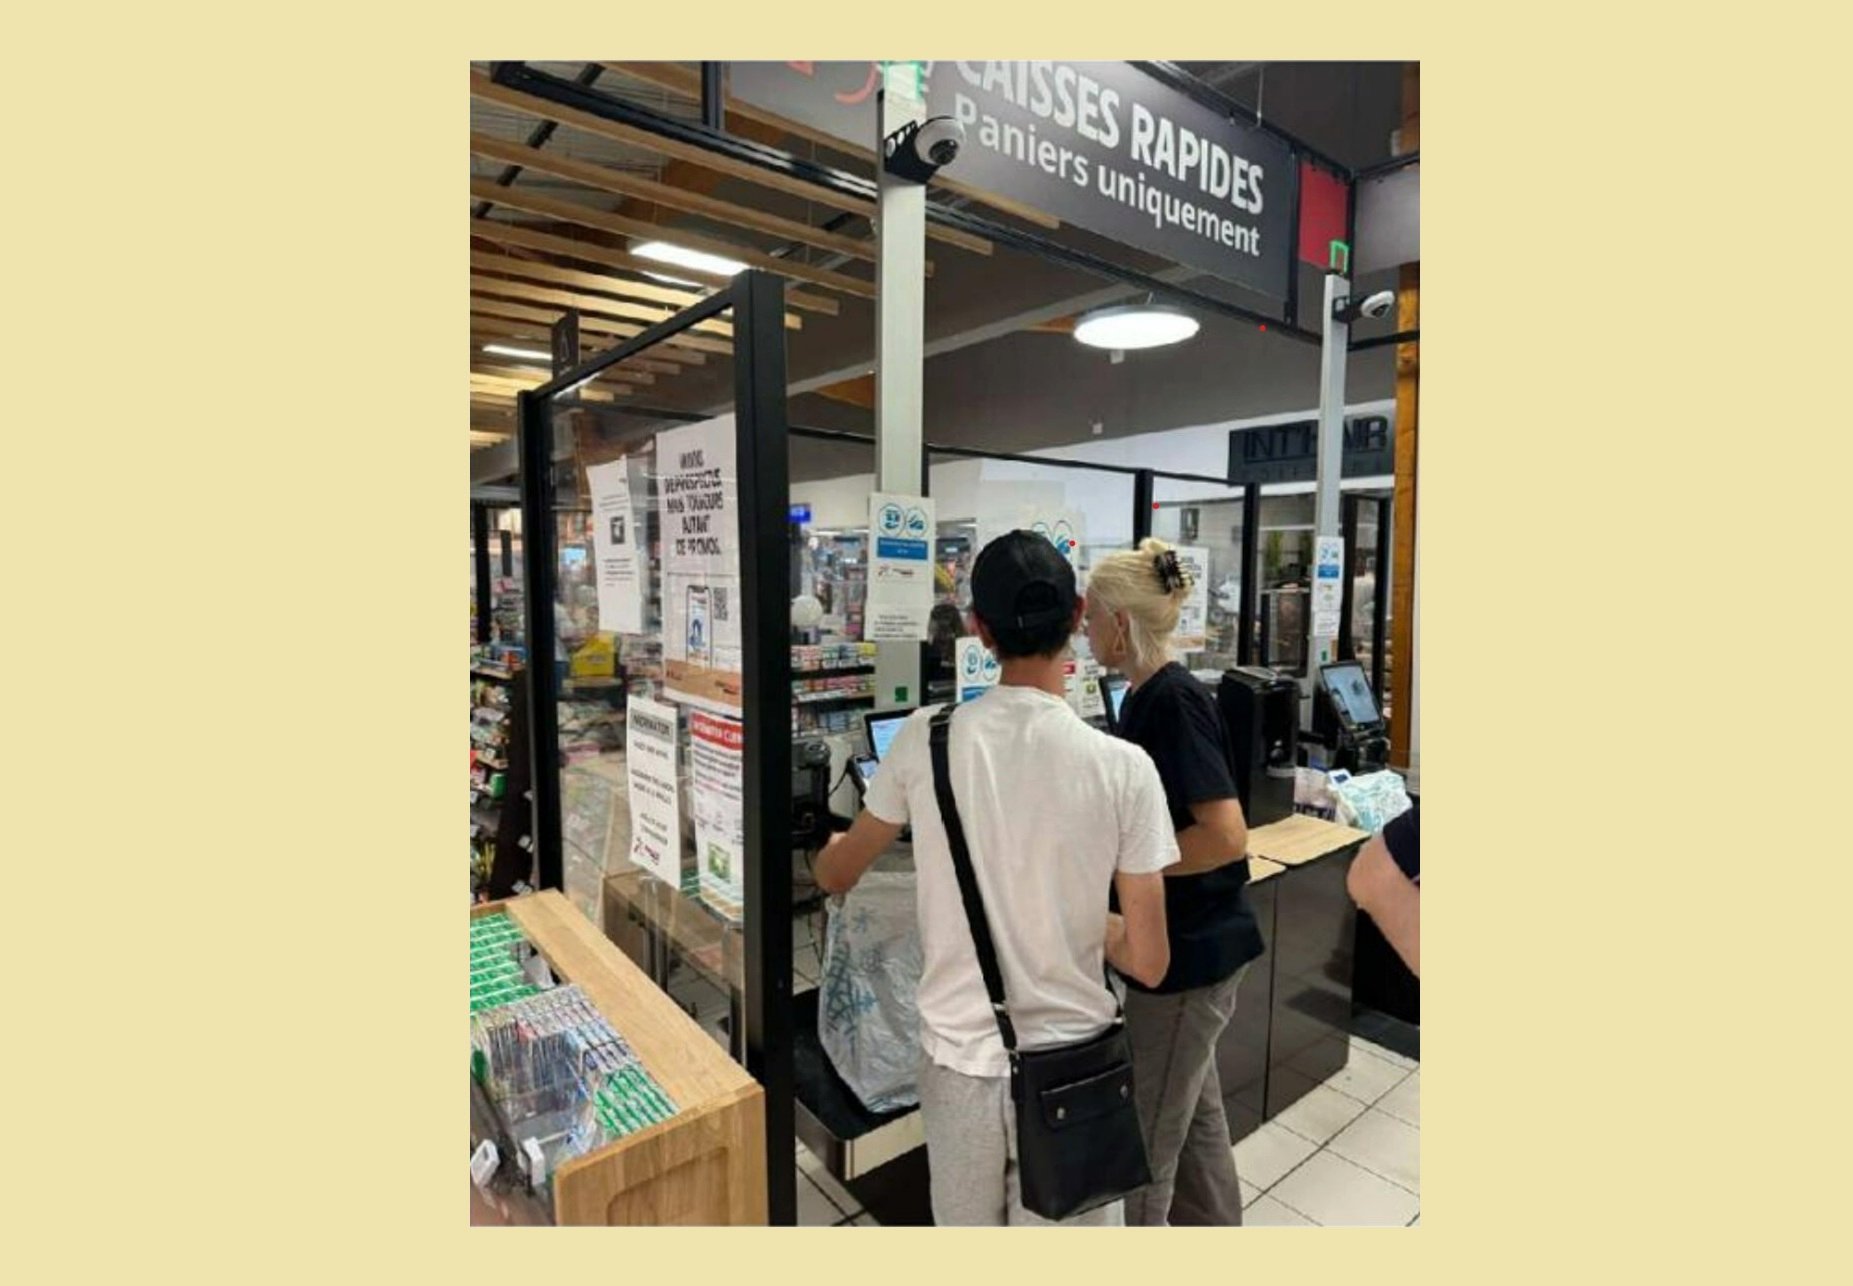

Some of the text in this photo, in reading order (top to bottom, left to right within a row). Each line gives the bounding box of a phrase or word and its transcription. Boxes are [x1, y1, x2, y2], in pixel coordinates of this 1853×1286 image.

[955, 92, 1260, 256] Paniers uniquement
[1131, 103, 1264, 214] RAPIDES
